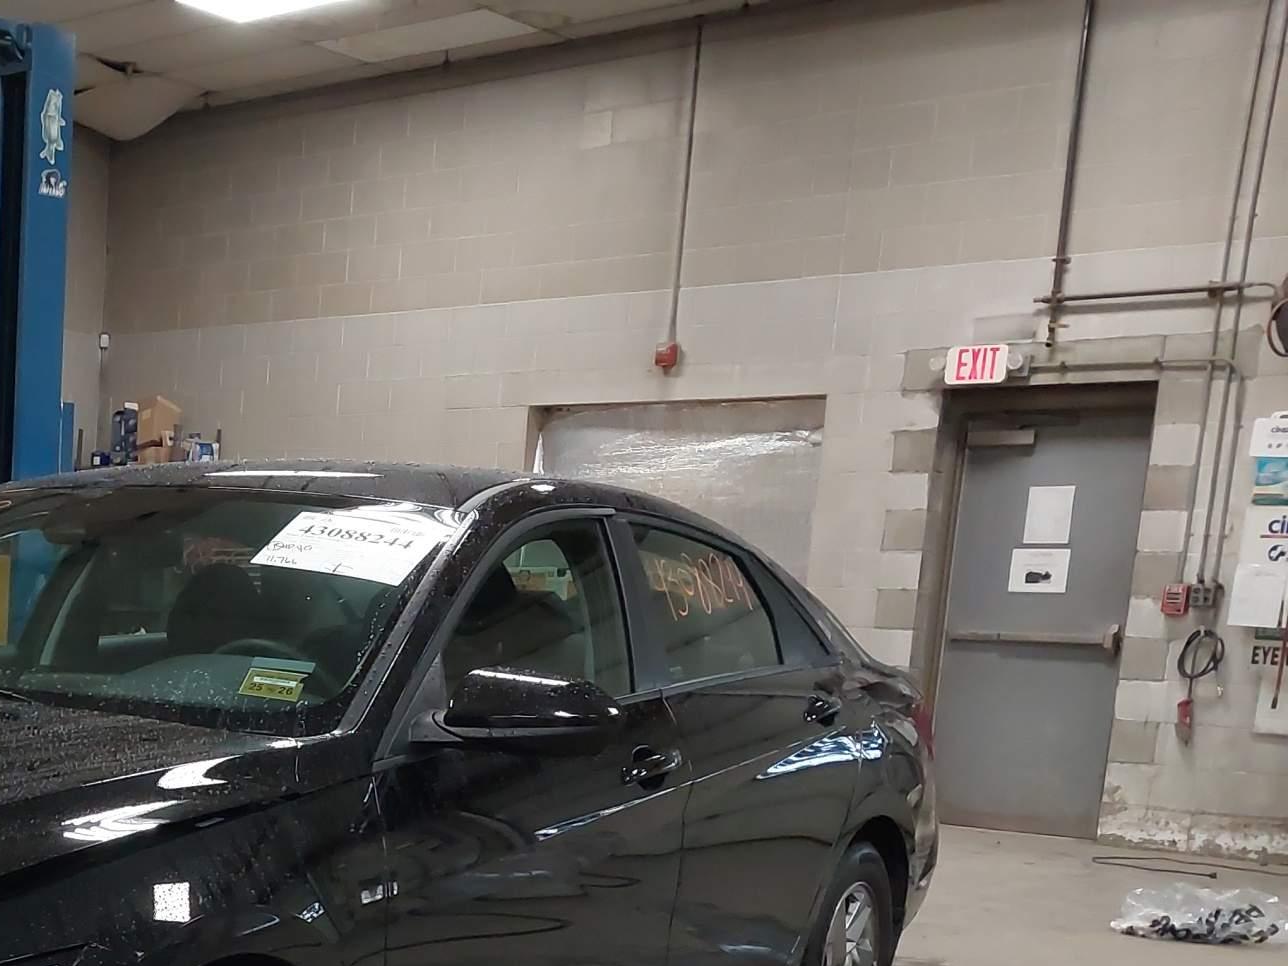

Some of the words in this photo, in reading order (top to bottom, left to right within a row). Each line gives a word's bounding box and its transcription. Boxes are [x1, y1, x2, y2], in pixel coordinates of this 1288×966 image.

[955, 347, 1001, 381] EXIT
[298, 523, 415, 550] 43088244
[1250, 645, 1281, 666] EYE
[248, 682, 264, 692] 25
[278, 686, 294, 696] 26
